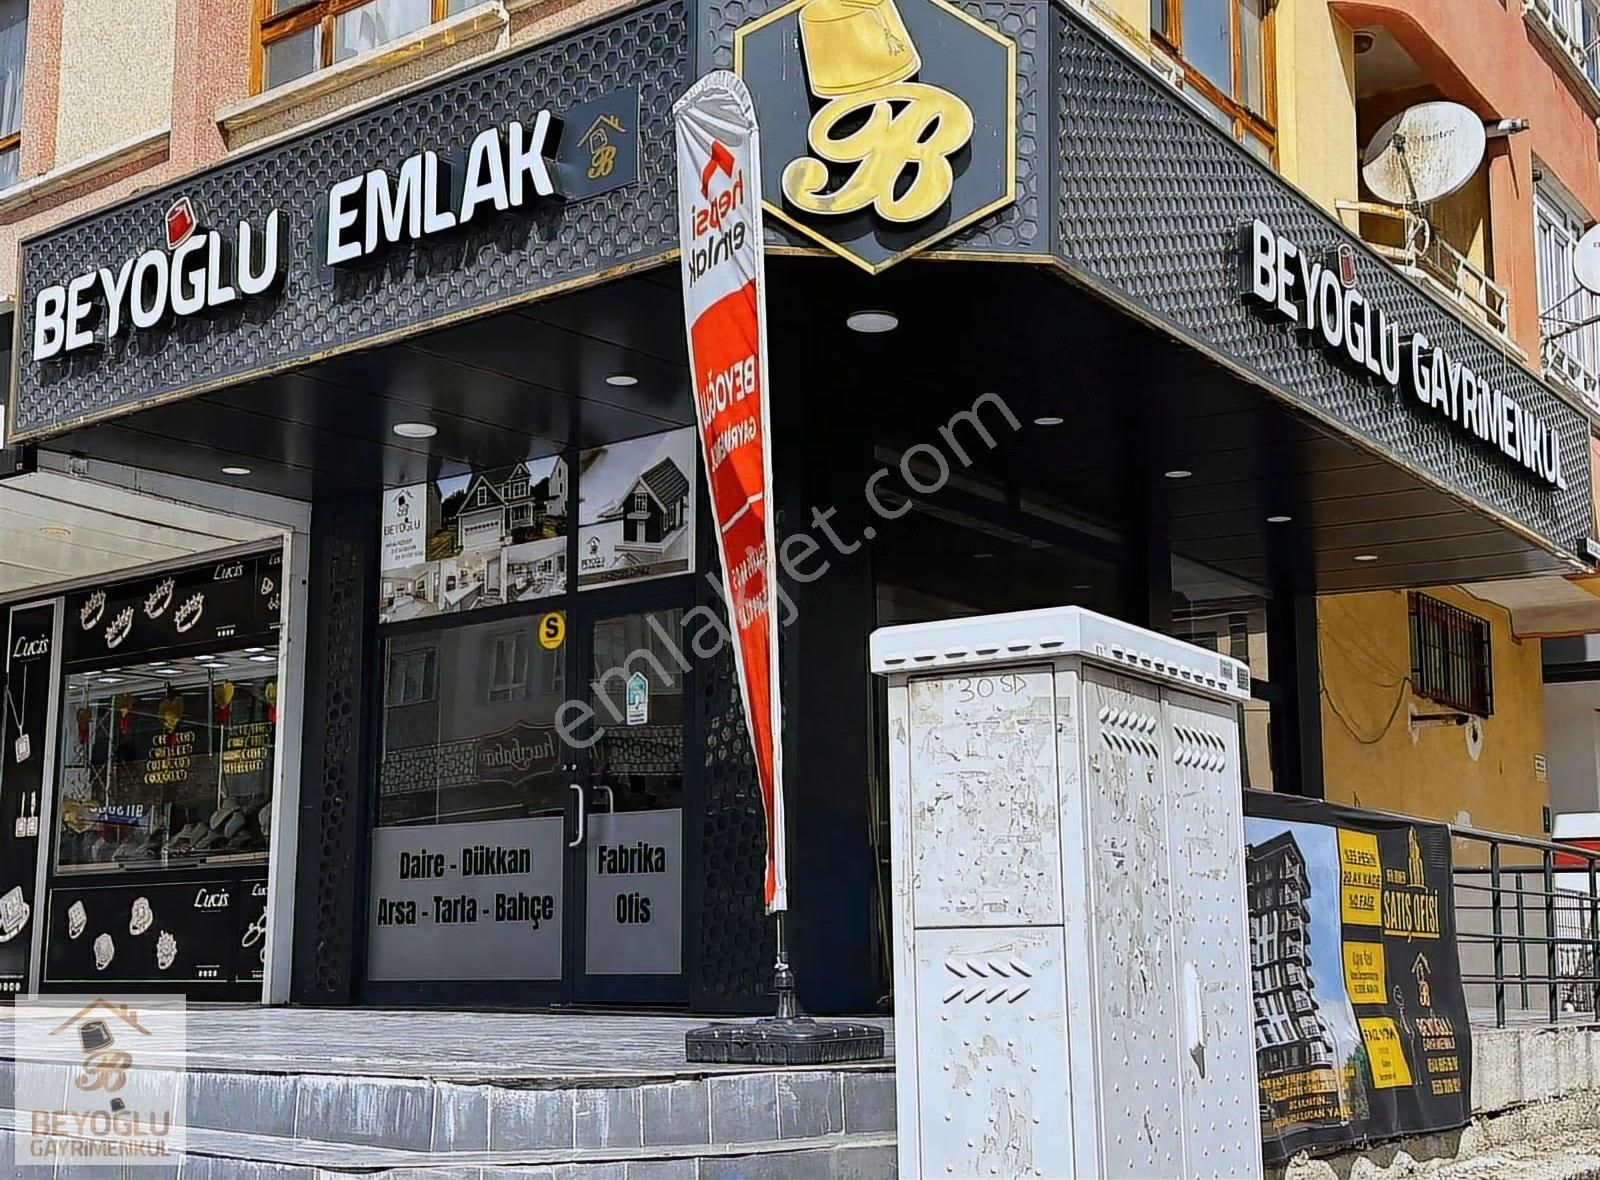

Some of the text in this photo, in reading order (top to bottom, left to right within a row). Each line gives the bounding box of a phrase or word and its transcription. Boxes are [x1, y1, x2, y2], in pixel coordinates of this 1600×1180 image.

[327, 109, 553, 266] EMLAK
[545, 616, 559, 638] S
[13, 633, 49, 658] Lucis
[957, 677, 994, 703] 30
[399, 849, 445, 879] Daire
[462, 845, 531, 876] Dükkan
[597, 841, 666, 875] Fabrika
[194, 888, 229, 907] Lucis
[377, 898, 417, 926] Arsa
[434, 895, 478, 924] Tarla
[495, 892, 554, 930] Bahçe
[616, 891, 651, 924] Ofis
